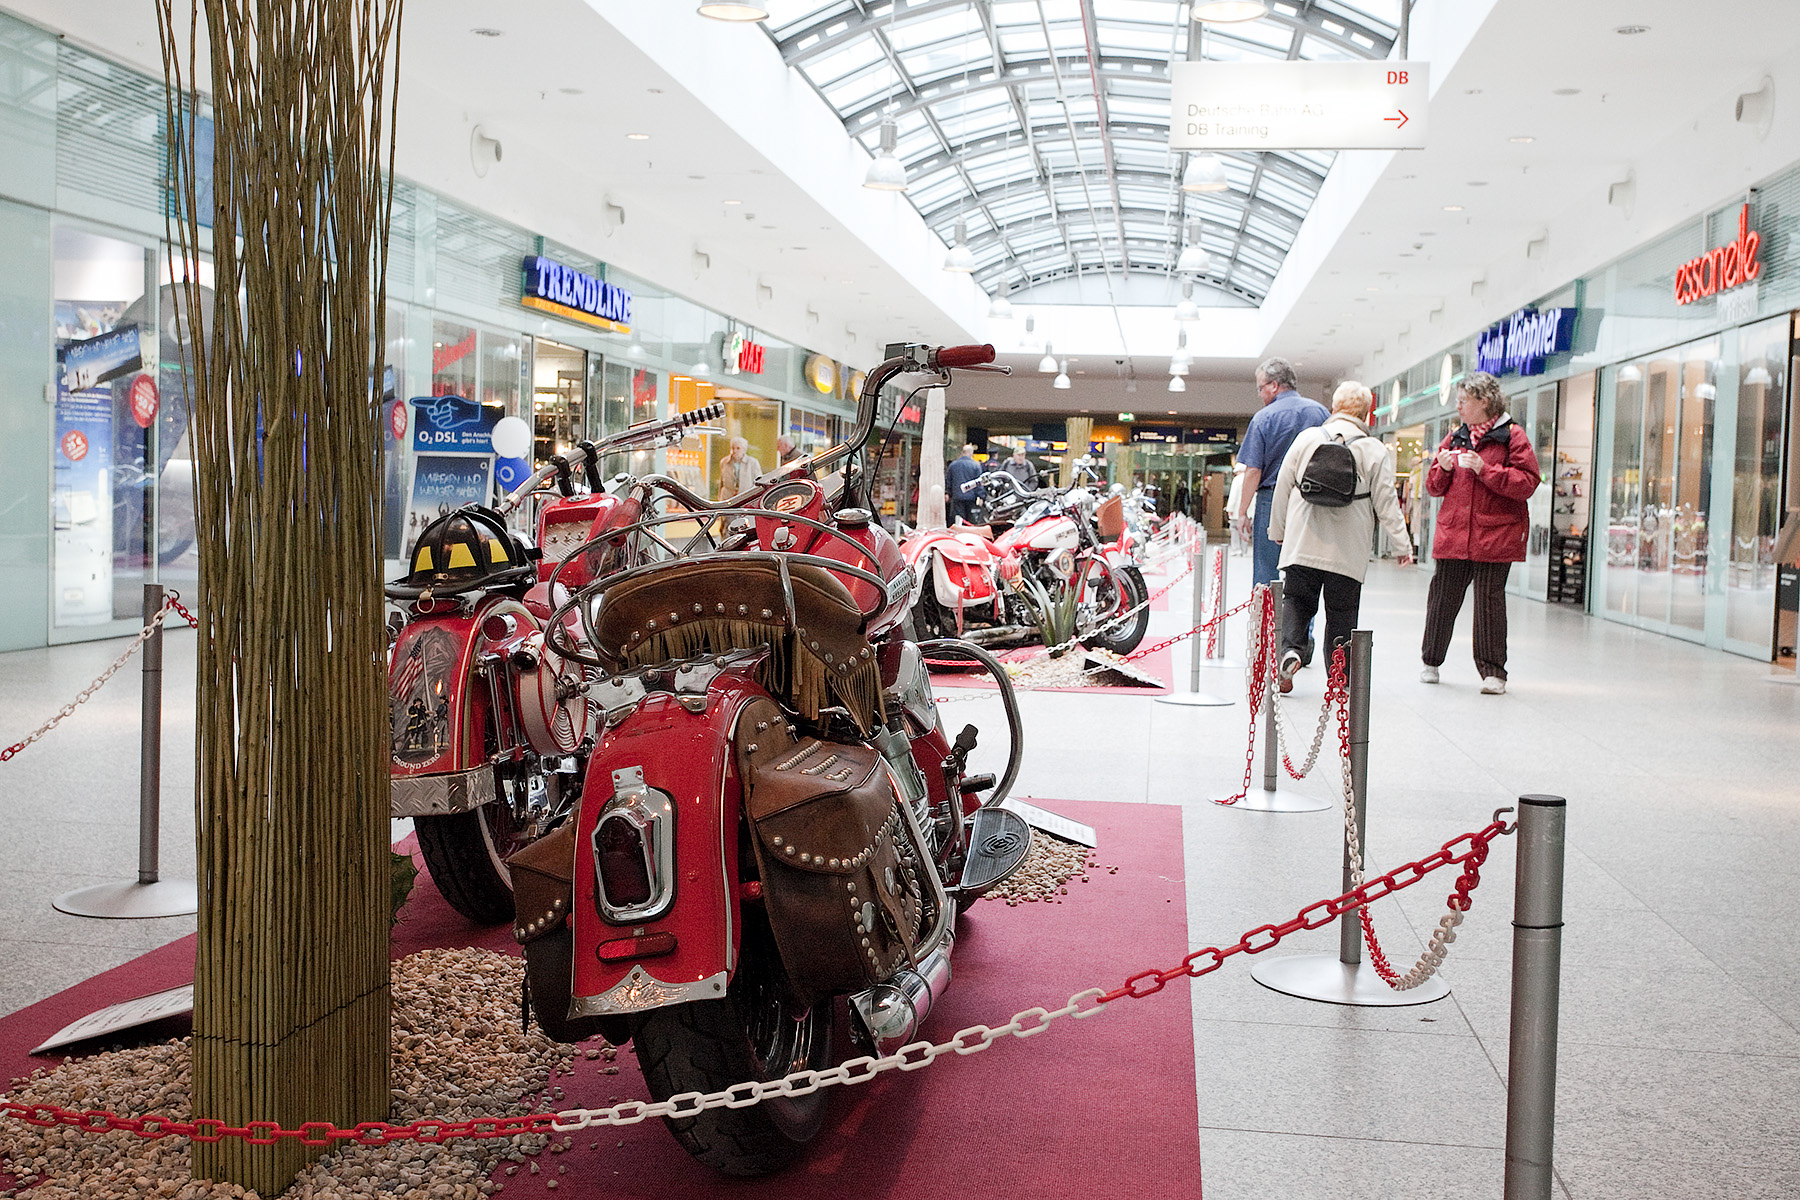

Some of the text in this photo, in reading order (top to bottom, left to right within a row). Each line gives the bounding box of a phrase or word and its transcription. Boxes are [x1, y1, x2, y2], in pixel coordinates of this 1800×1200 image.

[1387, 71, 1409, 85] DB
[1187, 104, 1256, 118] Deutsche
[1302, 104, 1325, 117] AG
[1186, 123, 1269, 139] DB Training
[1674, 203, 1760, 306] essanelle
[536, 256, 633, 324] TRENDLINE
[1505, 307, 1561, 375] Höppner
[434, 430, 458, 444] DSL
[392, 753, 441, 769] GROUND ZERO
